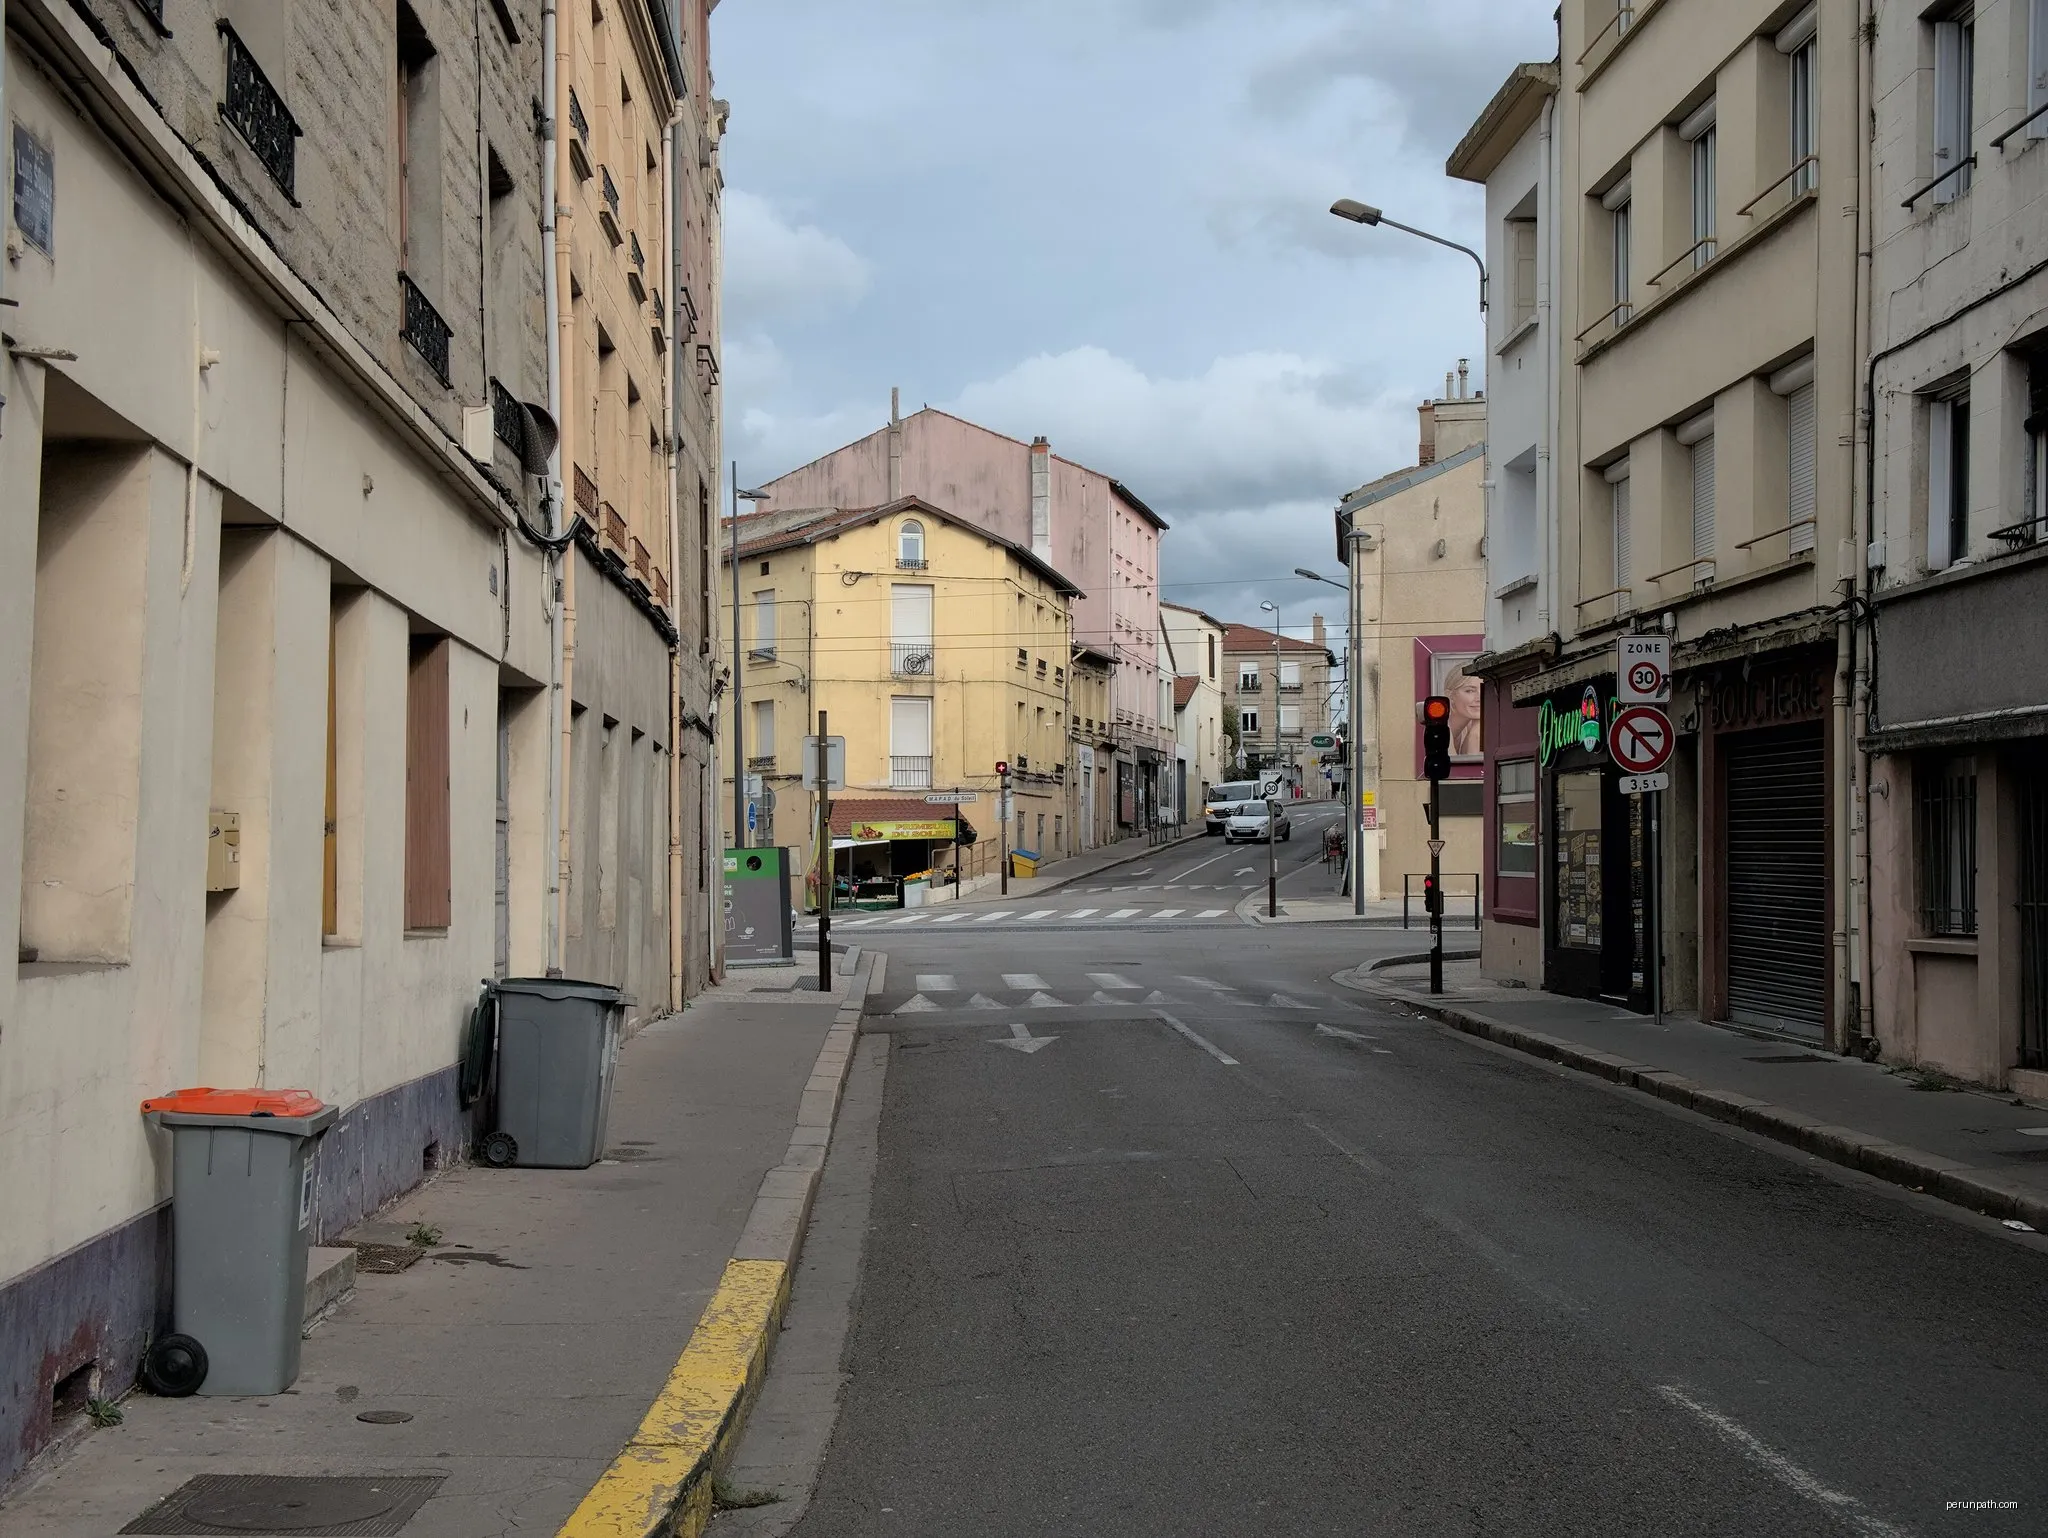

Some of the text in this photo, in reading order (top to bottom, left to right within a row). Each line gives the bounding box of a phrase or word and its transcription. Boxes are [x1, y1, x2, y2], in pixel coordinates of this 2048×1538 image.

[1627, 643, 1661, 653] ZONE
[1634, 670, 1655, 685] 30
[1711, 668, 1822, 727] BOUCHERIE
[1538, 698, 1582, 767] Dream
[1630, 779, 1658, 791] 3,5 t
